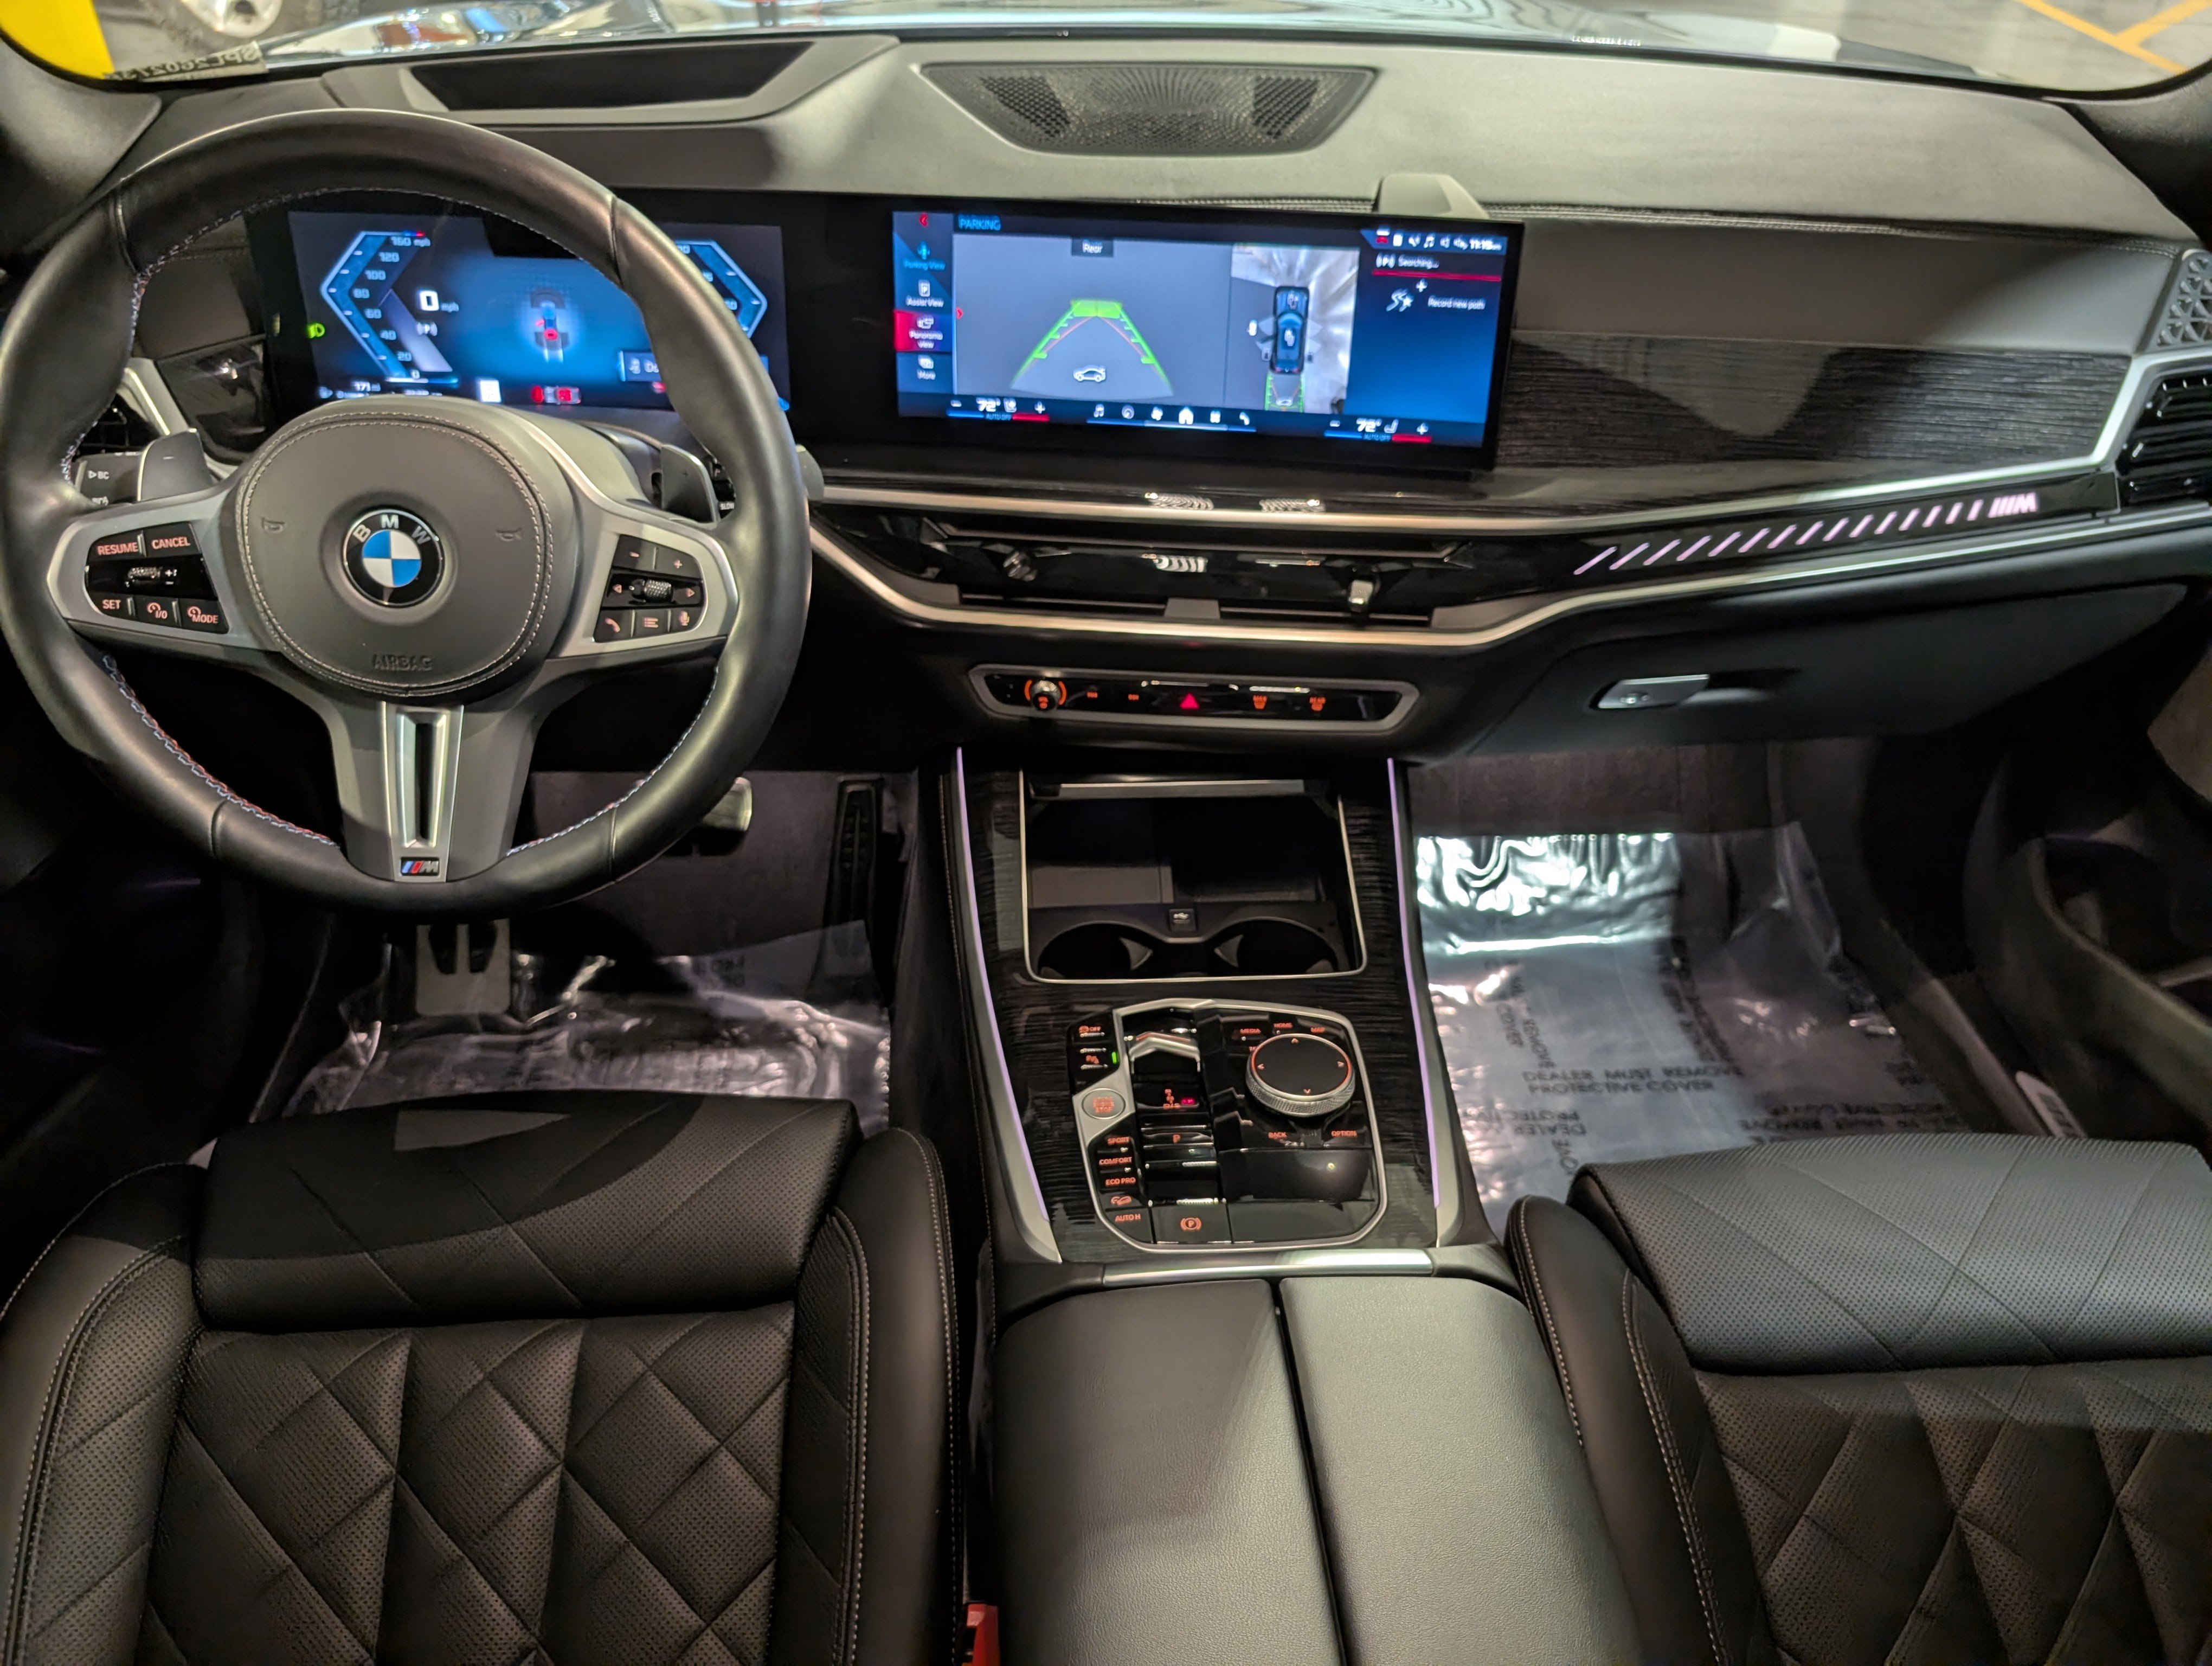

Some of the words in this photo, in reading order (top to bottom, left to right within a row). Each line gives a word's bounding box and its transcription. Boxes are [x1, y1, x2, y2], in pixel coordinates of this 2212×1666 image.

[958, 216, 1001, 230] PARKING
[413, 238, 430, 247] mph
[1083, 240, 1103, 254] Rear
[379, 253, 400, 262] 120
[903, 259, 928, 271] Parking
[929, 261, 946, 270] View
[365, 270, 386, 280] 100
[353, 289, 370, 299] 80
[419, 290, 440, 311] 0
[441, 302, 459, 312] mph
[364, 308, 382, 319] 60
[381, 329, 396, 341] 40
[909, 329, 943, 341] Panorama
[396, 351, 412, 362] 20
[411, 370, 420, 379] 0
[352, 514, 431, 545] BMW
[97, 542, 139, 555] RESUME
[151, 536, 191, 550] CANCEL
[101, 599, 121, 610] SET
[191, 614, 218, 624] MODE
[372, 654, 433, 671] AIRBAG
[1522, 1069, 1593, 1081] DEALER
[1604, 1067, 1652, 1080] MUST
[1647, 1080, 1714, 1093] COVER
[1107, 1136, 1130, 1145] SPORT
[1172, 1134, 1181, 1144] P
[1098, 1156, 1133, 1166] COMFORT
[1105, 1177, 1120, 1187] ECO
[1121, 1176, 1136, 1185] PRO
[1115, 1214, 1134, 1222] AUTO
